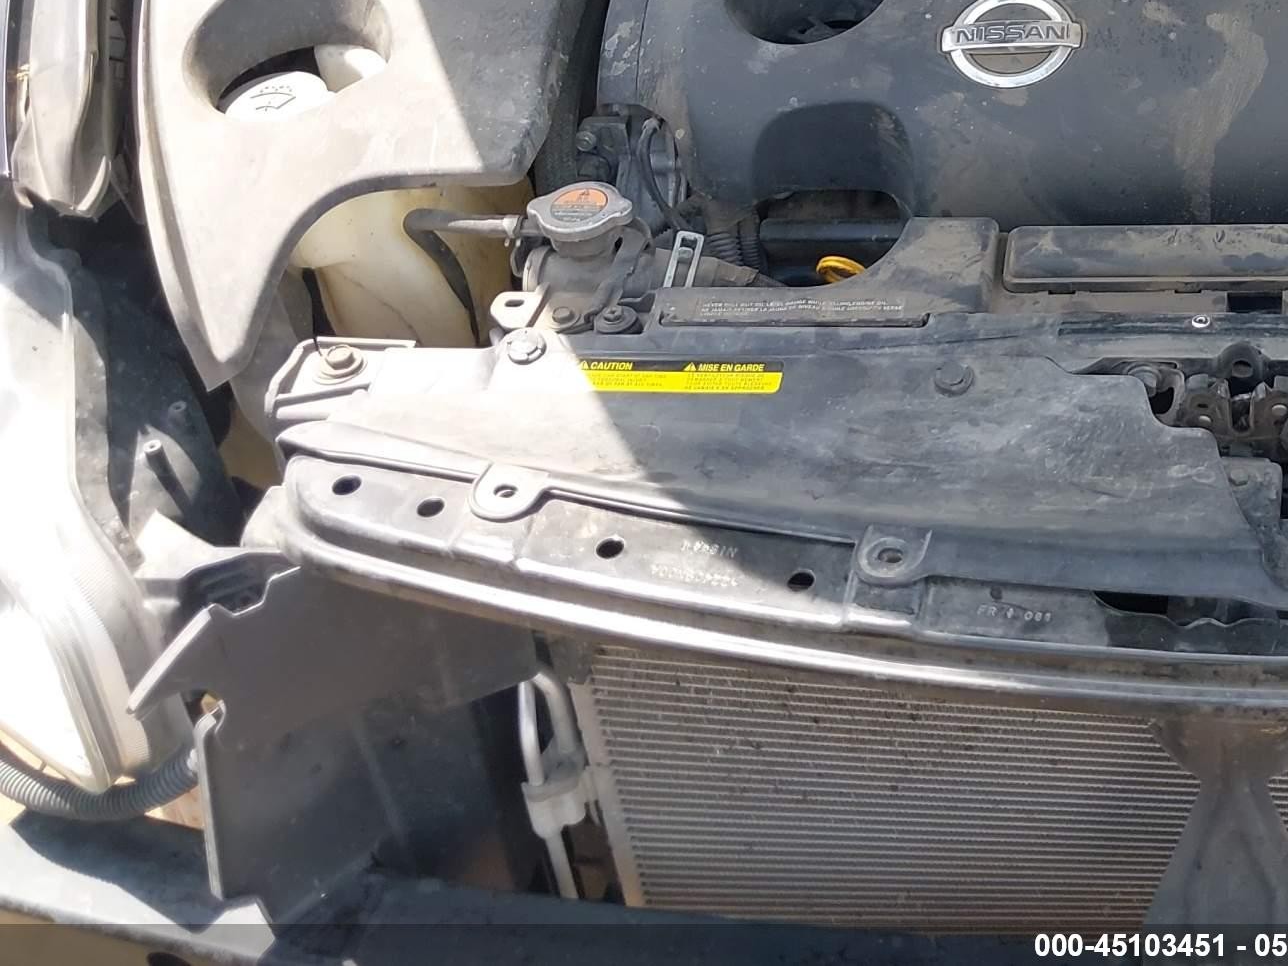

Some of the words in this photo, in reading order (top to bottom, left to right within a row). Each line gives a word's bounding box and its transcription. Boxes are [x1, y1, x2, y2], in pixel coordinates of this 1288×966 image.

[956, 25, 1067, 44] NISSAN
[590, 361, 633, 371] CAUTION
[698, 363, 720, 372] MISE
[720, 363, 734, 372] EN
[734, 363, 765, 372] GARDE
